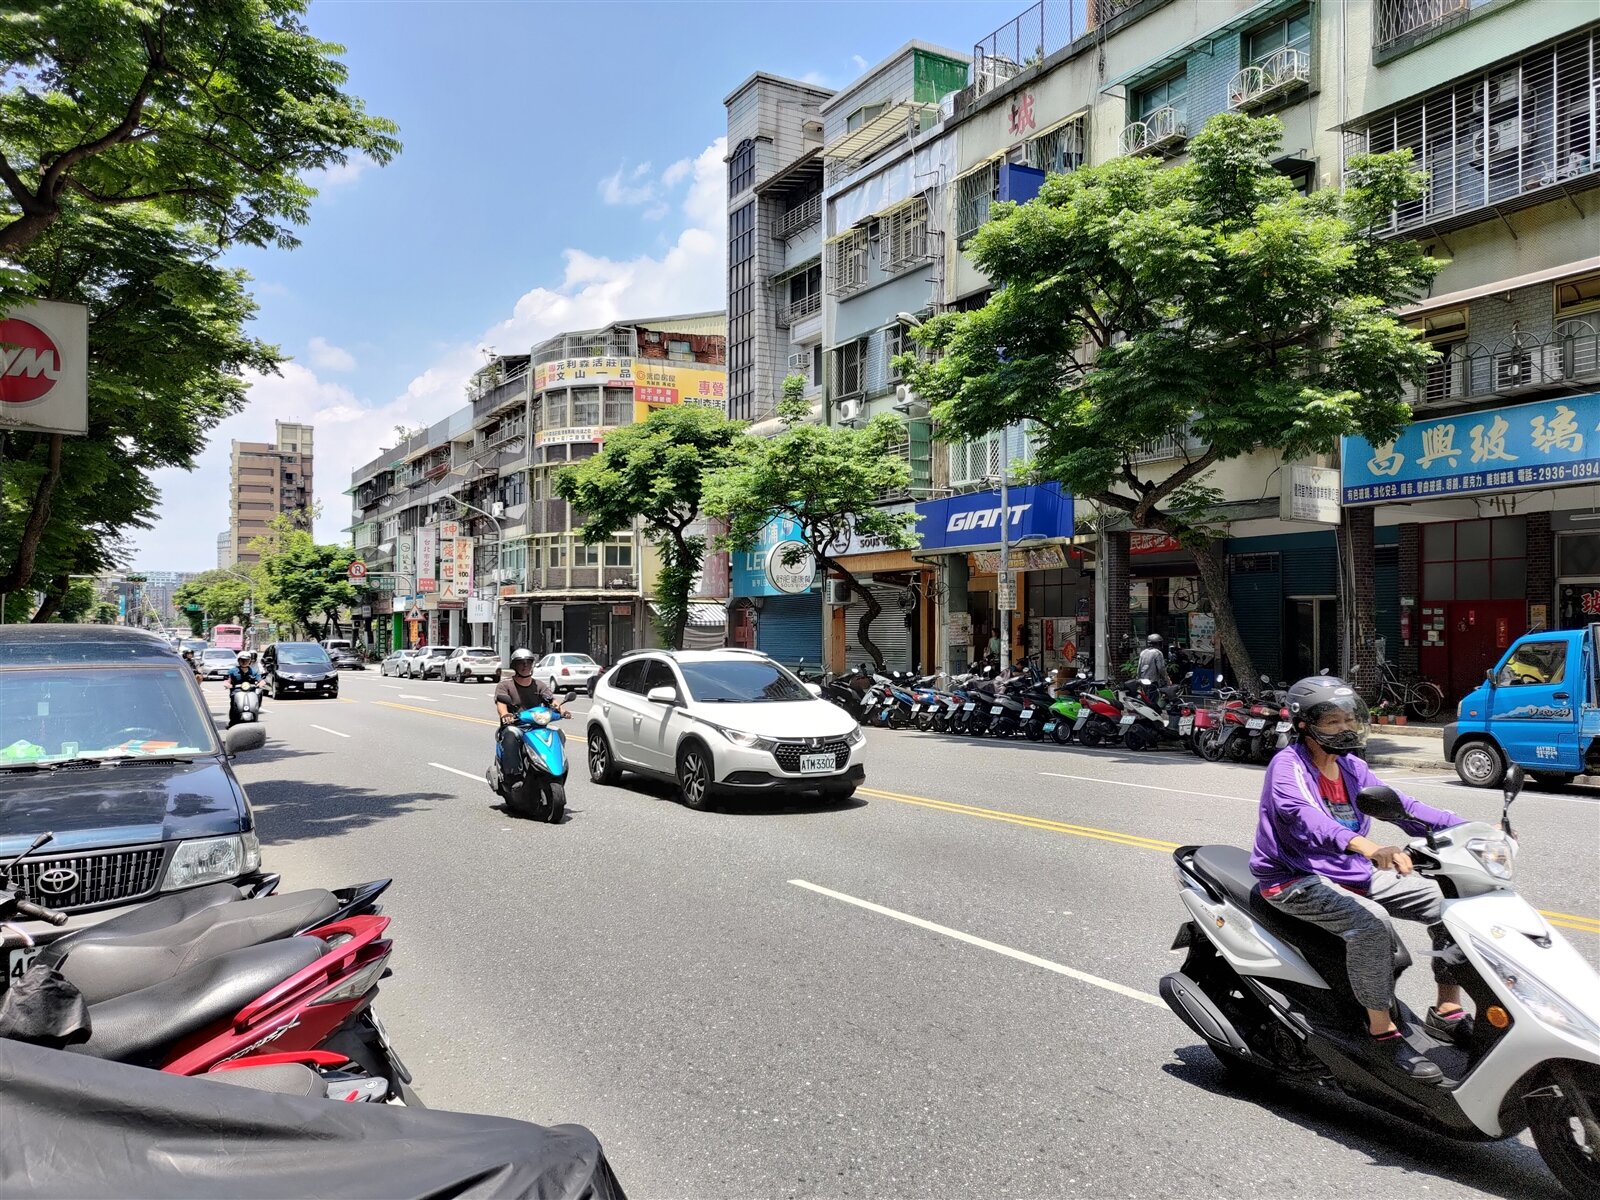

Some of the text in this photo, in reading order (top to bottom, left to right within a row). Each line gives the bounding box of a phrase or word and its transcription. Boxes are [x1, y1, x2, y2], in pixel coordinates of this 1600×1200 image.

[1008, 92, 1036, 136] 城
[557, 358, 632, 370] 元利森活莊園
[557, 369, 631, 381] 文山一品
[699, 380, 725, 397] 專營
[946, 503, 1033, 532] GIANT
[859, 537, 880, 549] SOUS
[443, 523, 458, 597] 神愛世人
